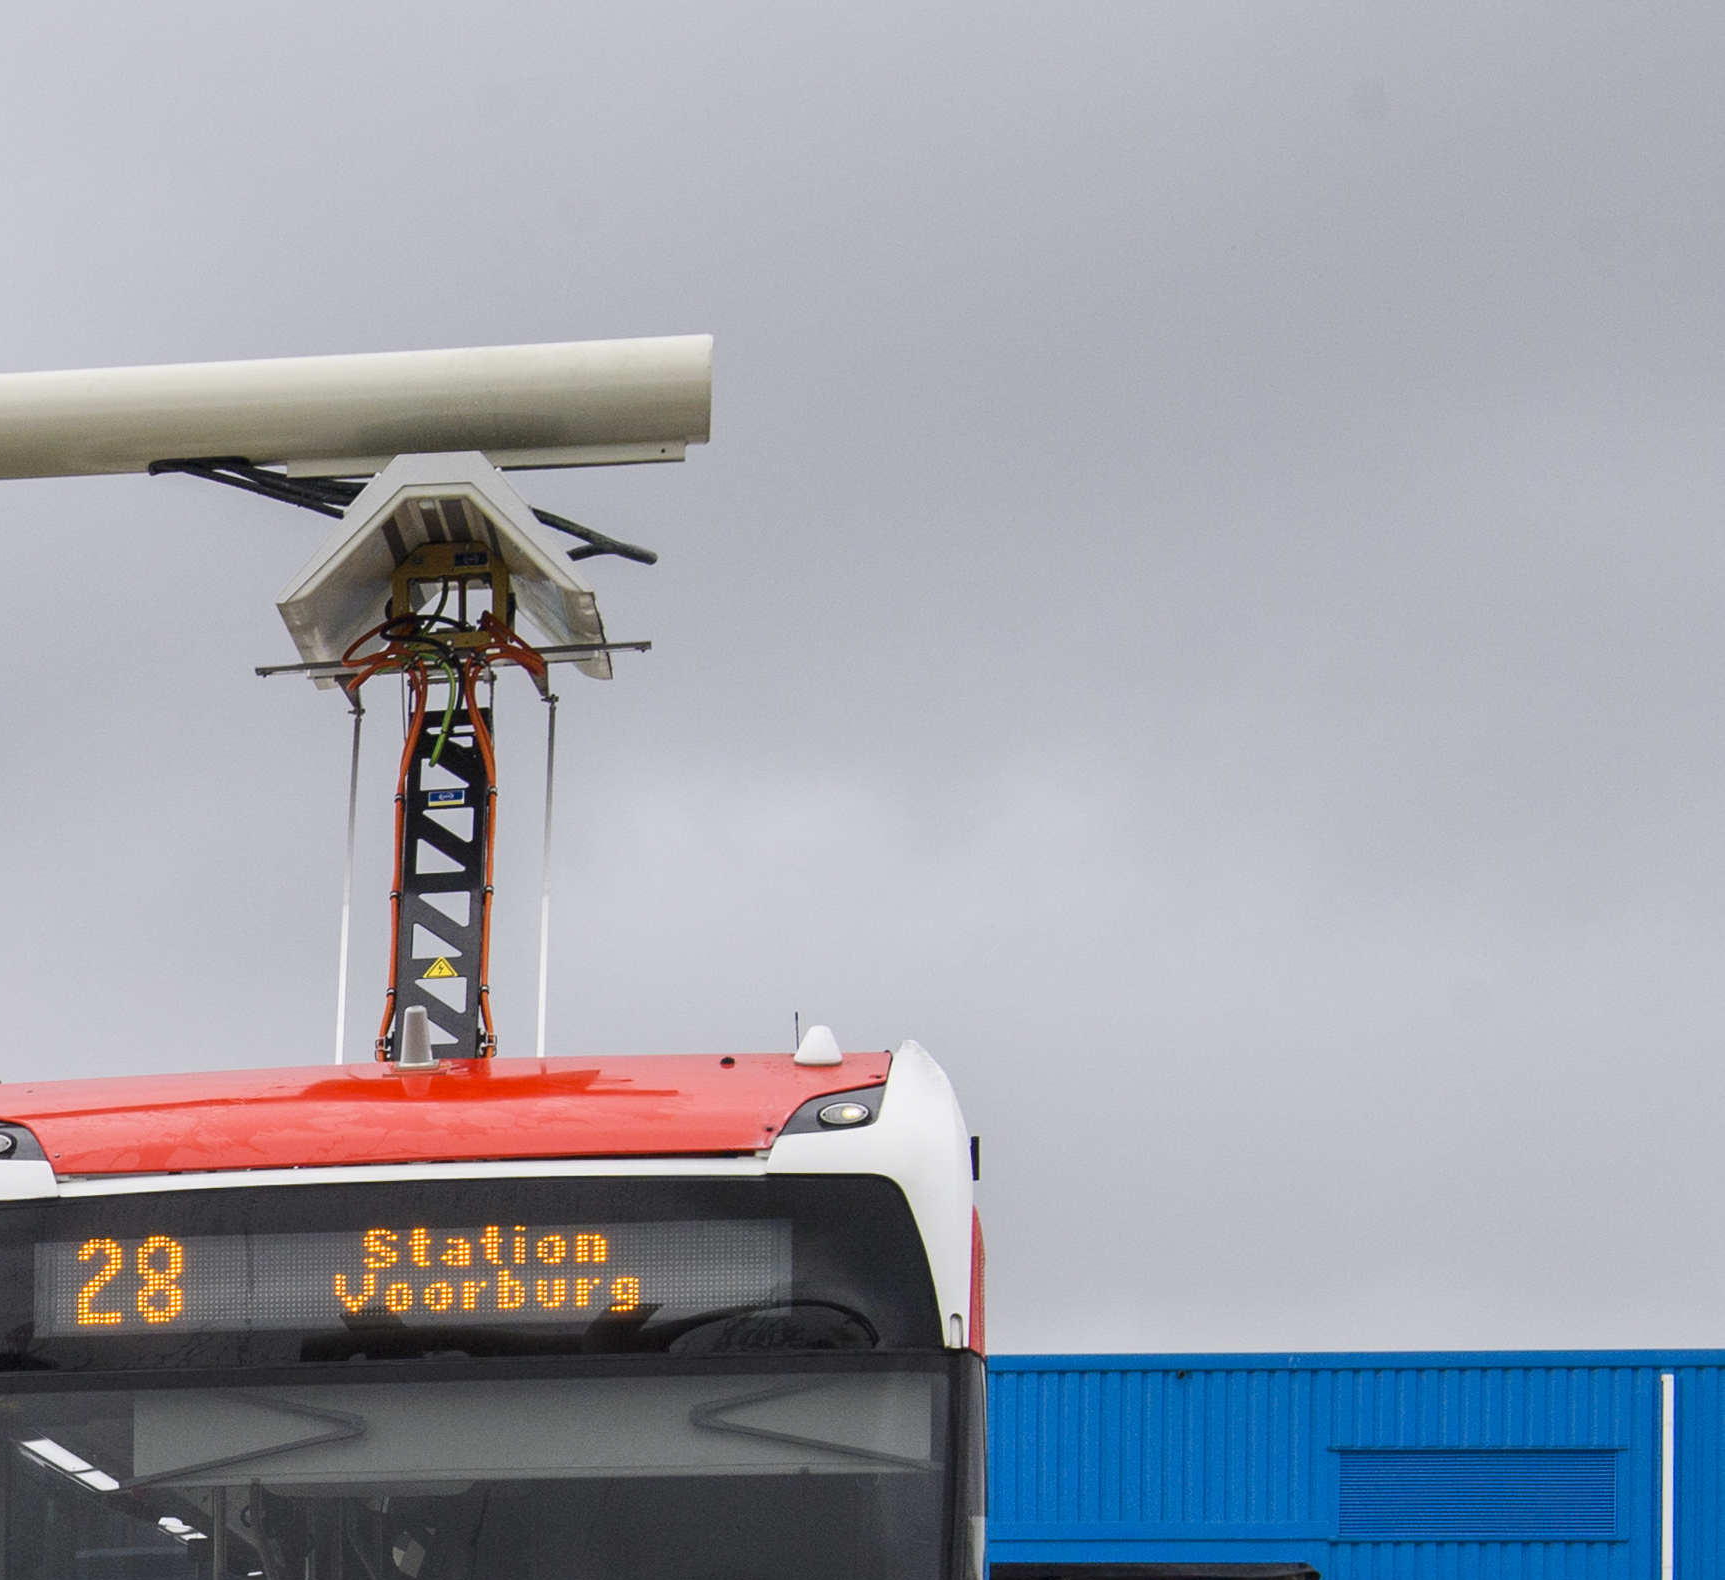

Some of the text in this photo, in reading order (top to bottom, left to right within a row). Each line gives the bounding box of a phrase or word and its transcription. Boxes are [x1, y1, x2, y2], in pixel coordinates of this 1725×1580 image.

[77, 1225, 606, 1324] 28 Station
[335, 1269, 639, 1312] Voorburg
